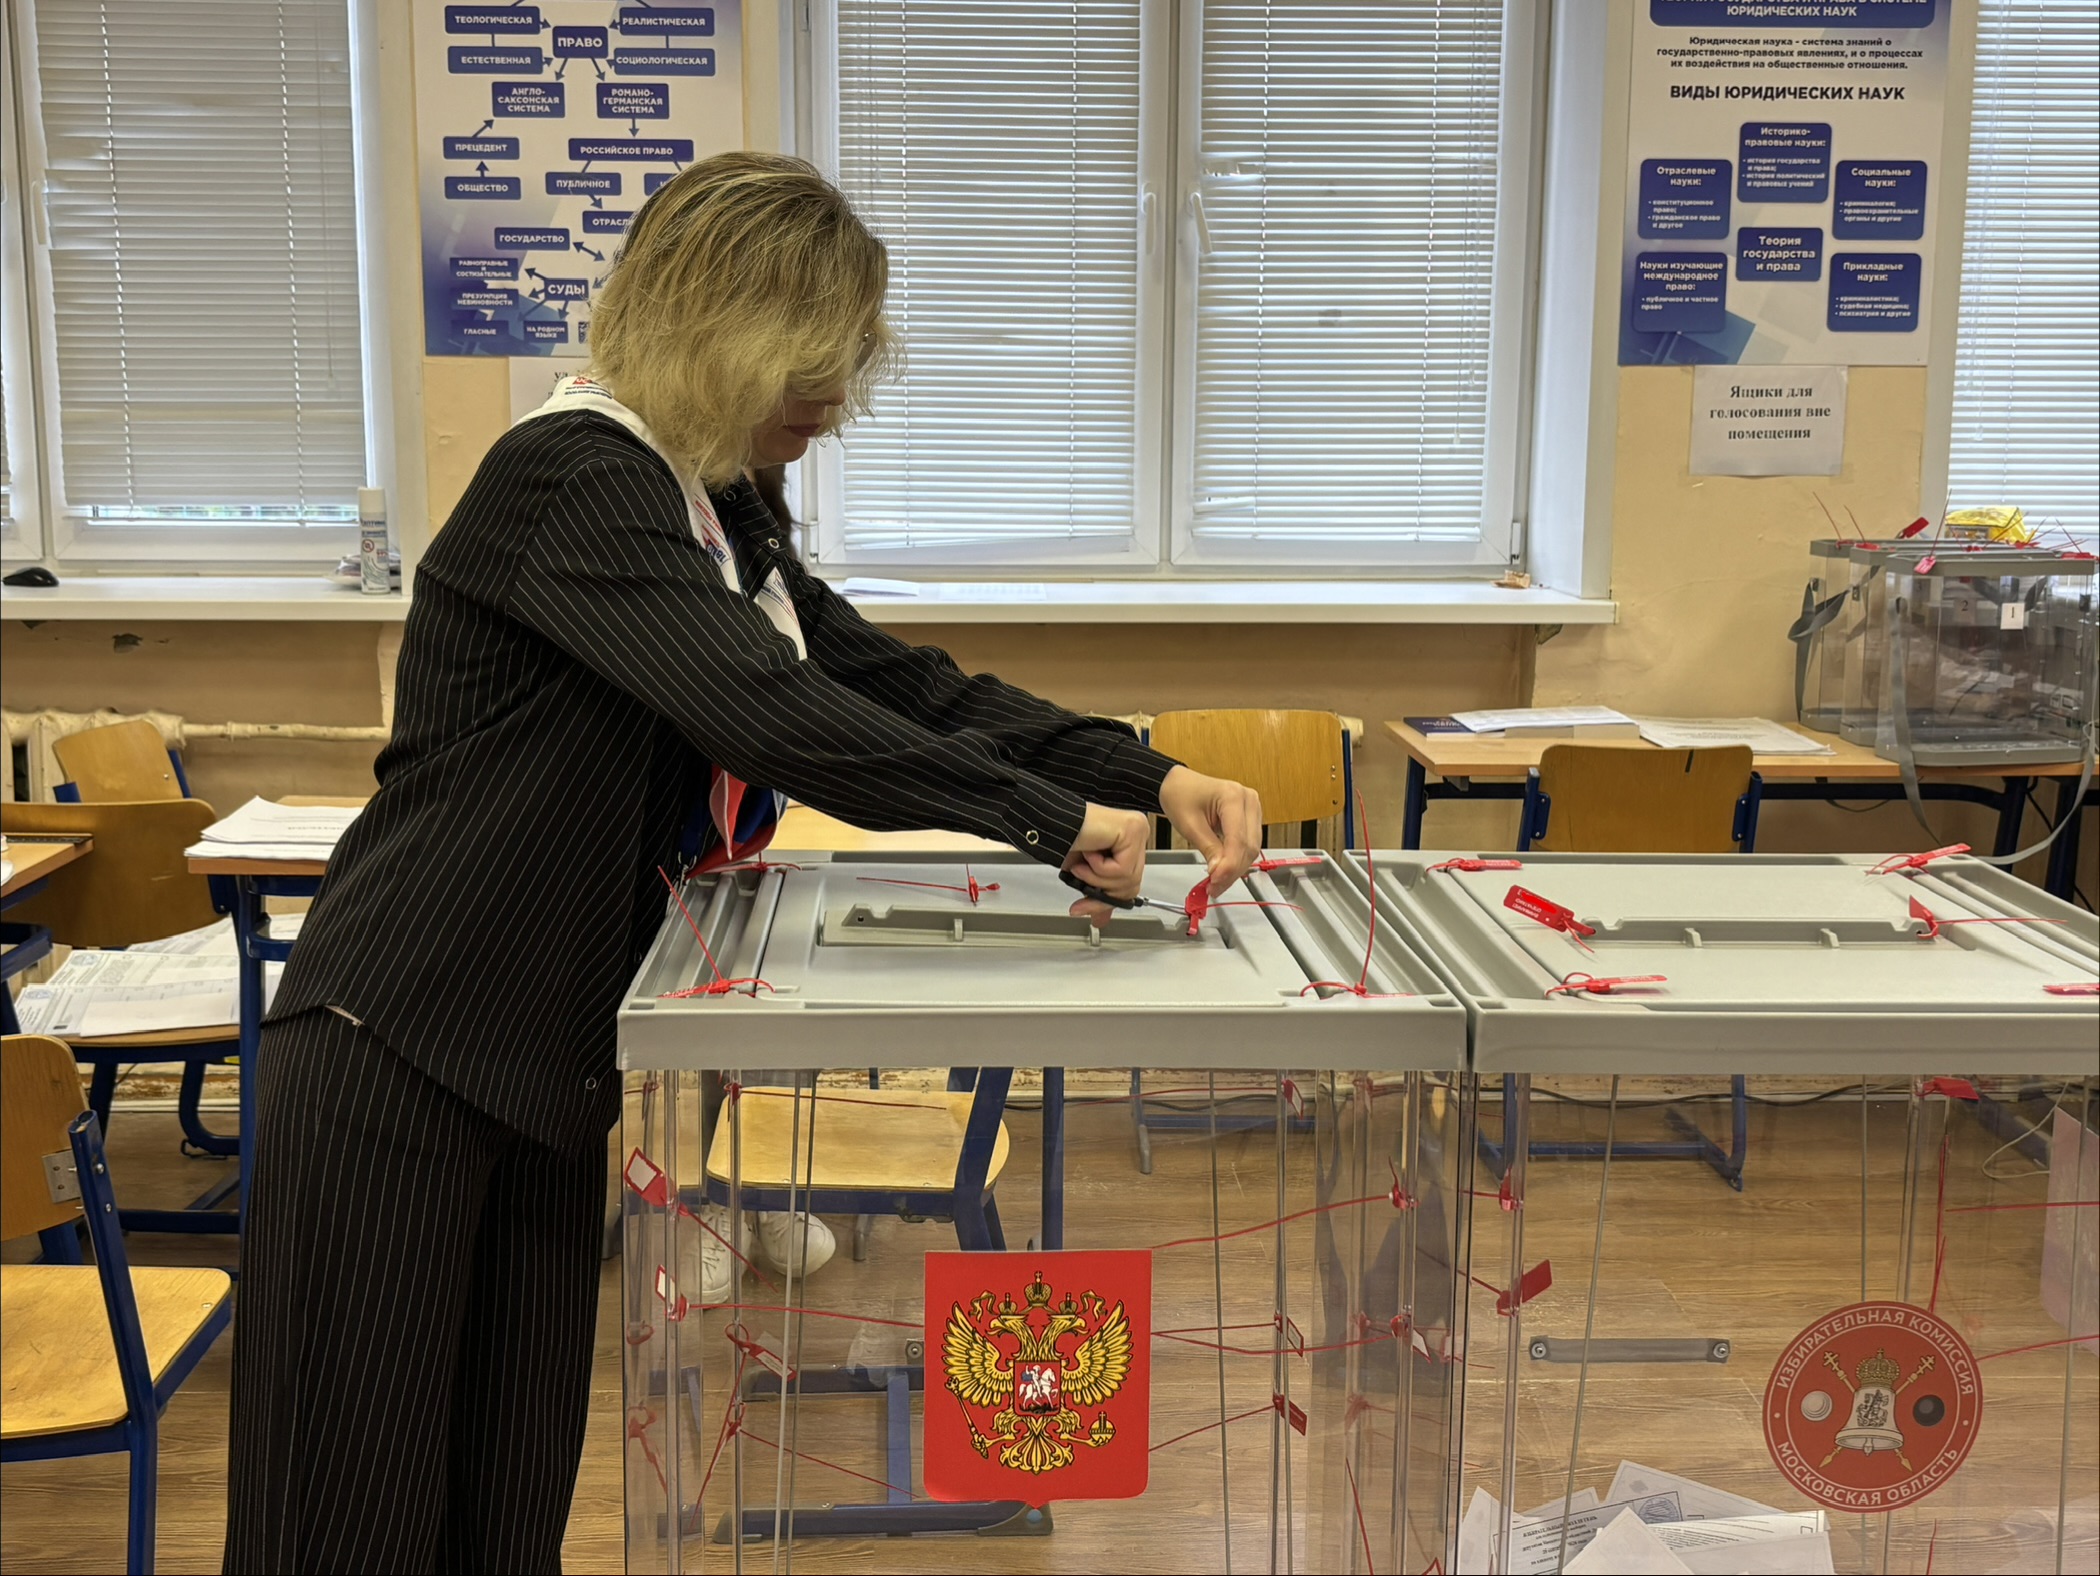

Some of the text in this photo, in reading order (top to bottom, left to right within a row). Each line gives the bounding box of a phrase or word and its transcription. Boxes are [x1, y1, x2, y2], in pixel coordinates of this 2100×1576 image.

[1727, 6, 1857, 17] ЮРИДИЧЕСКИХ НАУК
[454, 16, 533, 25] ТЕОЛОГИЧЕСКАЯ
[622, 17, 706, 26] РЕАЛИСТИЧЕСКАЯ
[557, 38, 603, 48] ПРАВО
[1689, 37, 1760, 47] Юридическая
[1763, 38, 1792, 47] наука
[1846, 37, 1883, 46] знаний
[1657, 48, 1794, 58] государственно-правовых
[1796, 50, 1848, 59] явлениях,
[1869, 51, 1923, 59] процессах
[461, 56, 531, 65] ЕСТЕСТВЕННАЯ
[616, 56, 708, 66] СОЦИОЛОГИЧЕСКАЯ
[1670, 60, 1683, 68] их
[1686, 59, 1750, 69] воздействия
[1767, 60, 1845, 69] общественные
[1847, 61, 1908, 70] отношения.
[511, 87, 546, 96] АНГЛО-
[611, 89, 654, 97] РОМАНО-
[1670, 86, 1905, 101] ВИДЫ ЮРИДИЧЕСКИХ НАУК
[497, 96, 560, 105] САКСОНСКАЯ
[603, 97, 663, 106] ГЕРМАНСКАЯ
[507, 104, 550, 113] СИСТЕМА
[612, 105, 655, 114] СИСТЕМА
[1761, 127, 1811, 137] Историко-
[455, 144, 508, 153] ПРЕЦЕДЕНТ
[1745, 139, 1826, 148] правовые науки:
[580, 145, 674, 156] РОССИЙСКОЕ ПРАВО
[1656, 166, 1716, 176] Отраслевые
[1851, 168, 1911, 178] Социальные
[556, 179, 611, 188] ПУБЛИЧНОЕ
[1670, 178, 1702, 187] науки:
[1864, 179, 1897, 188] науки:
[457, 183, 509, 193] ОБЩЕСТВО
[499, 234, 565, 244] ГОСУДАРСТВО
[1758, 236, 1802, 247] Теория
[1743, 249, 1816, 260] государства
[1640, 261, 1724, 271] Науки изучающие
[1756, 263, 1801, 273] и права
[1843, 262, 1904, 272] Прикладные
[1643, 272, 1719, 281] международное
[1856, 273, 1888, 282] науки:
[547, 284, 585, 295] СУДЫ
[1730, 385, 1813, 399] Ящики для
[1709, 407, 1832, 419] голосования вне
[1728, 428, 1811, 441] помещения
[1960, 599, 1969, 612] 2
[2010, 606, 2015, 619] 1
[1777, 1310, 1974, 1395] ИЗБИРАТЕЛЬНАЯ КОМИССИЯ
[1777, 1441, 1958, 1505] МОСКОВСКАЯ ОБЛАСТЬ
